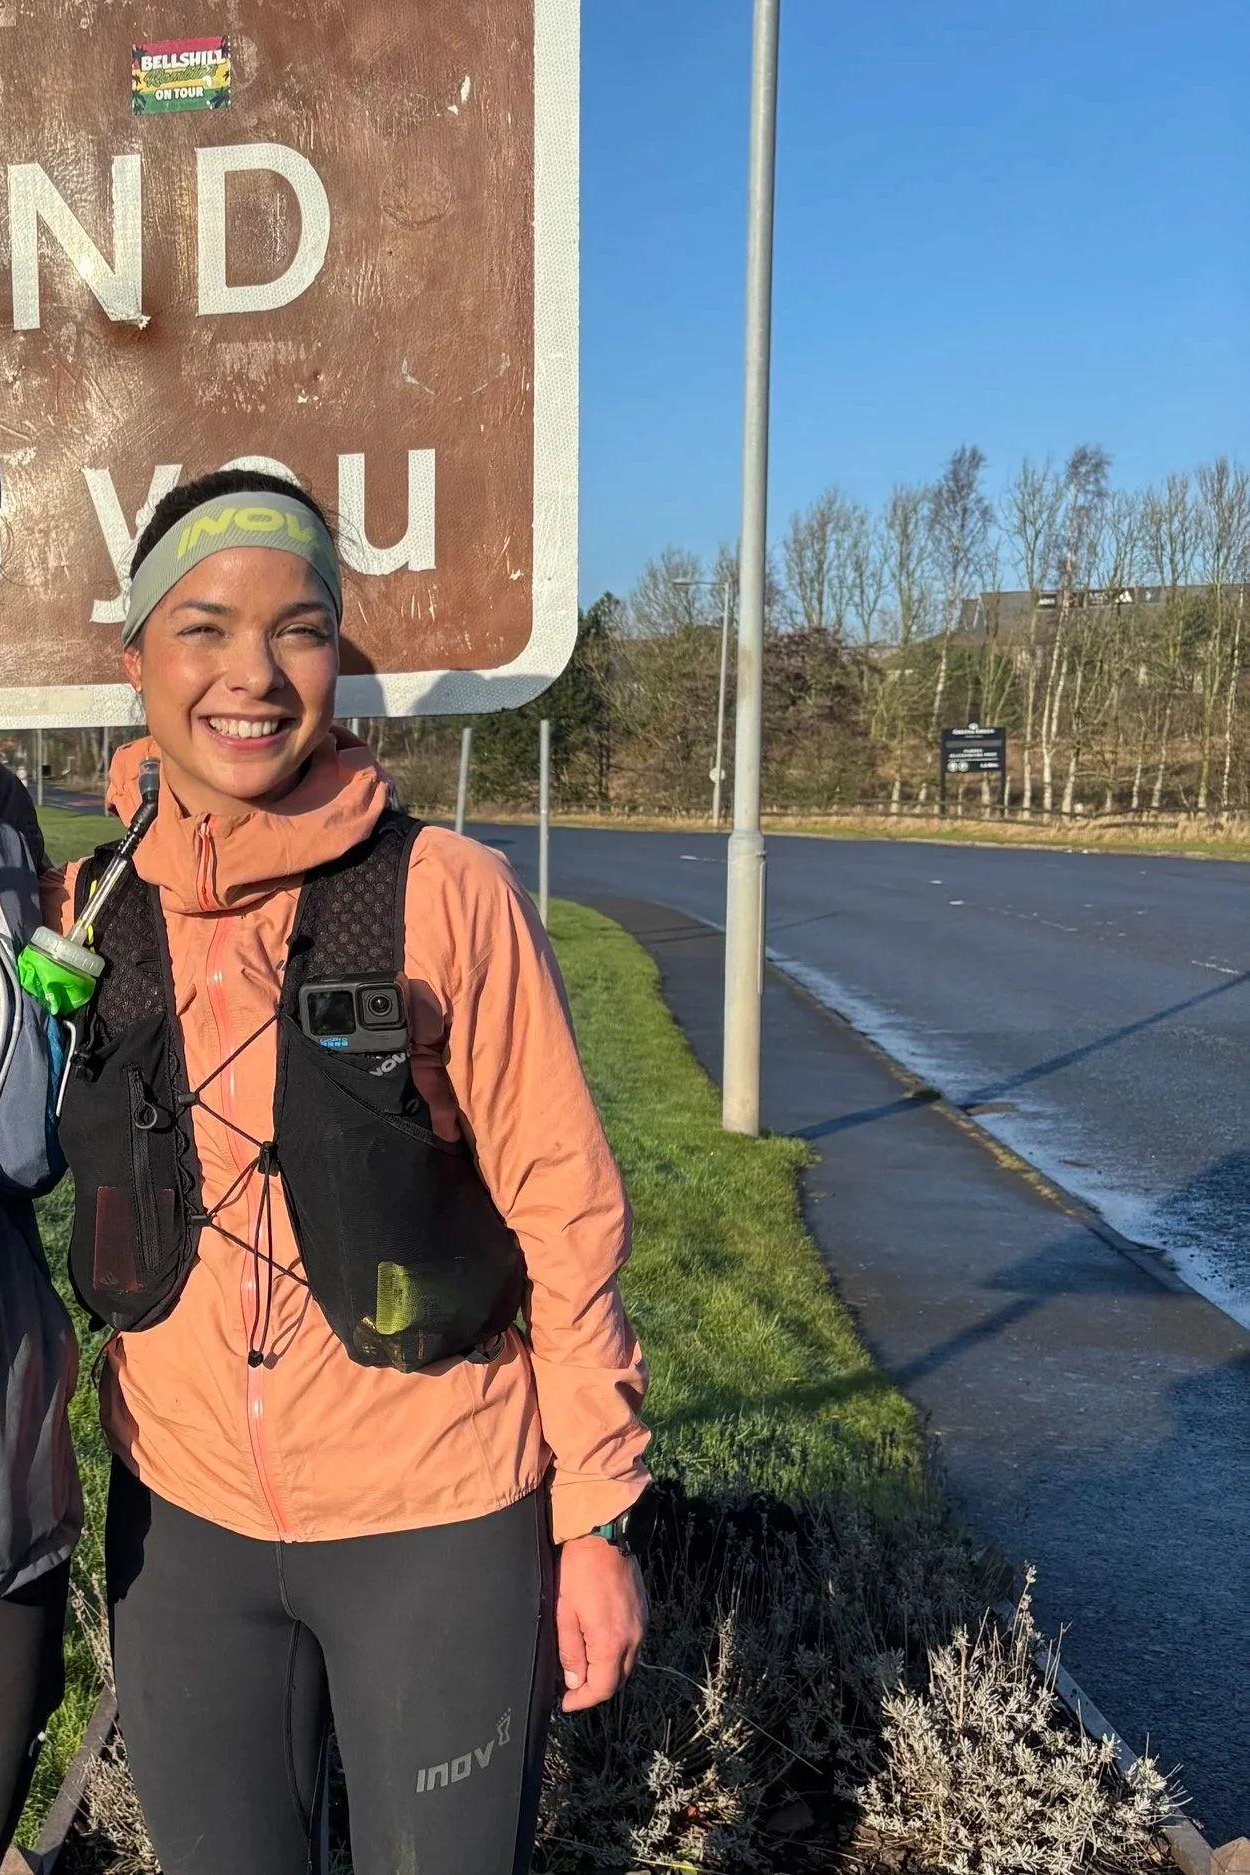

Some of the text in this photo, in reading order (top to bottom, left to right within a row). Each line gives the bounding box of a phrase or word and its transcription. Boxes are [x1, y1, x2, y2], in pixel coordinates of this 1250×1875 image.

[141, 49, 225, 72] BELLSHILL
[155, 87, 204, 100] ON TOUR
[81, 448, 436, 624] yu
